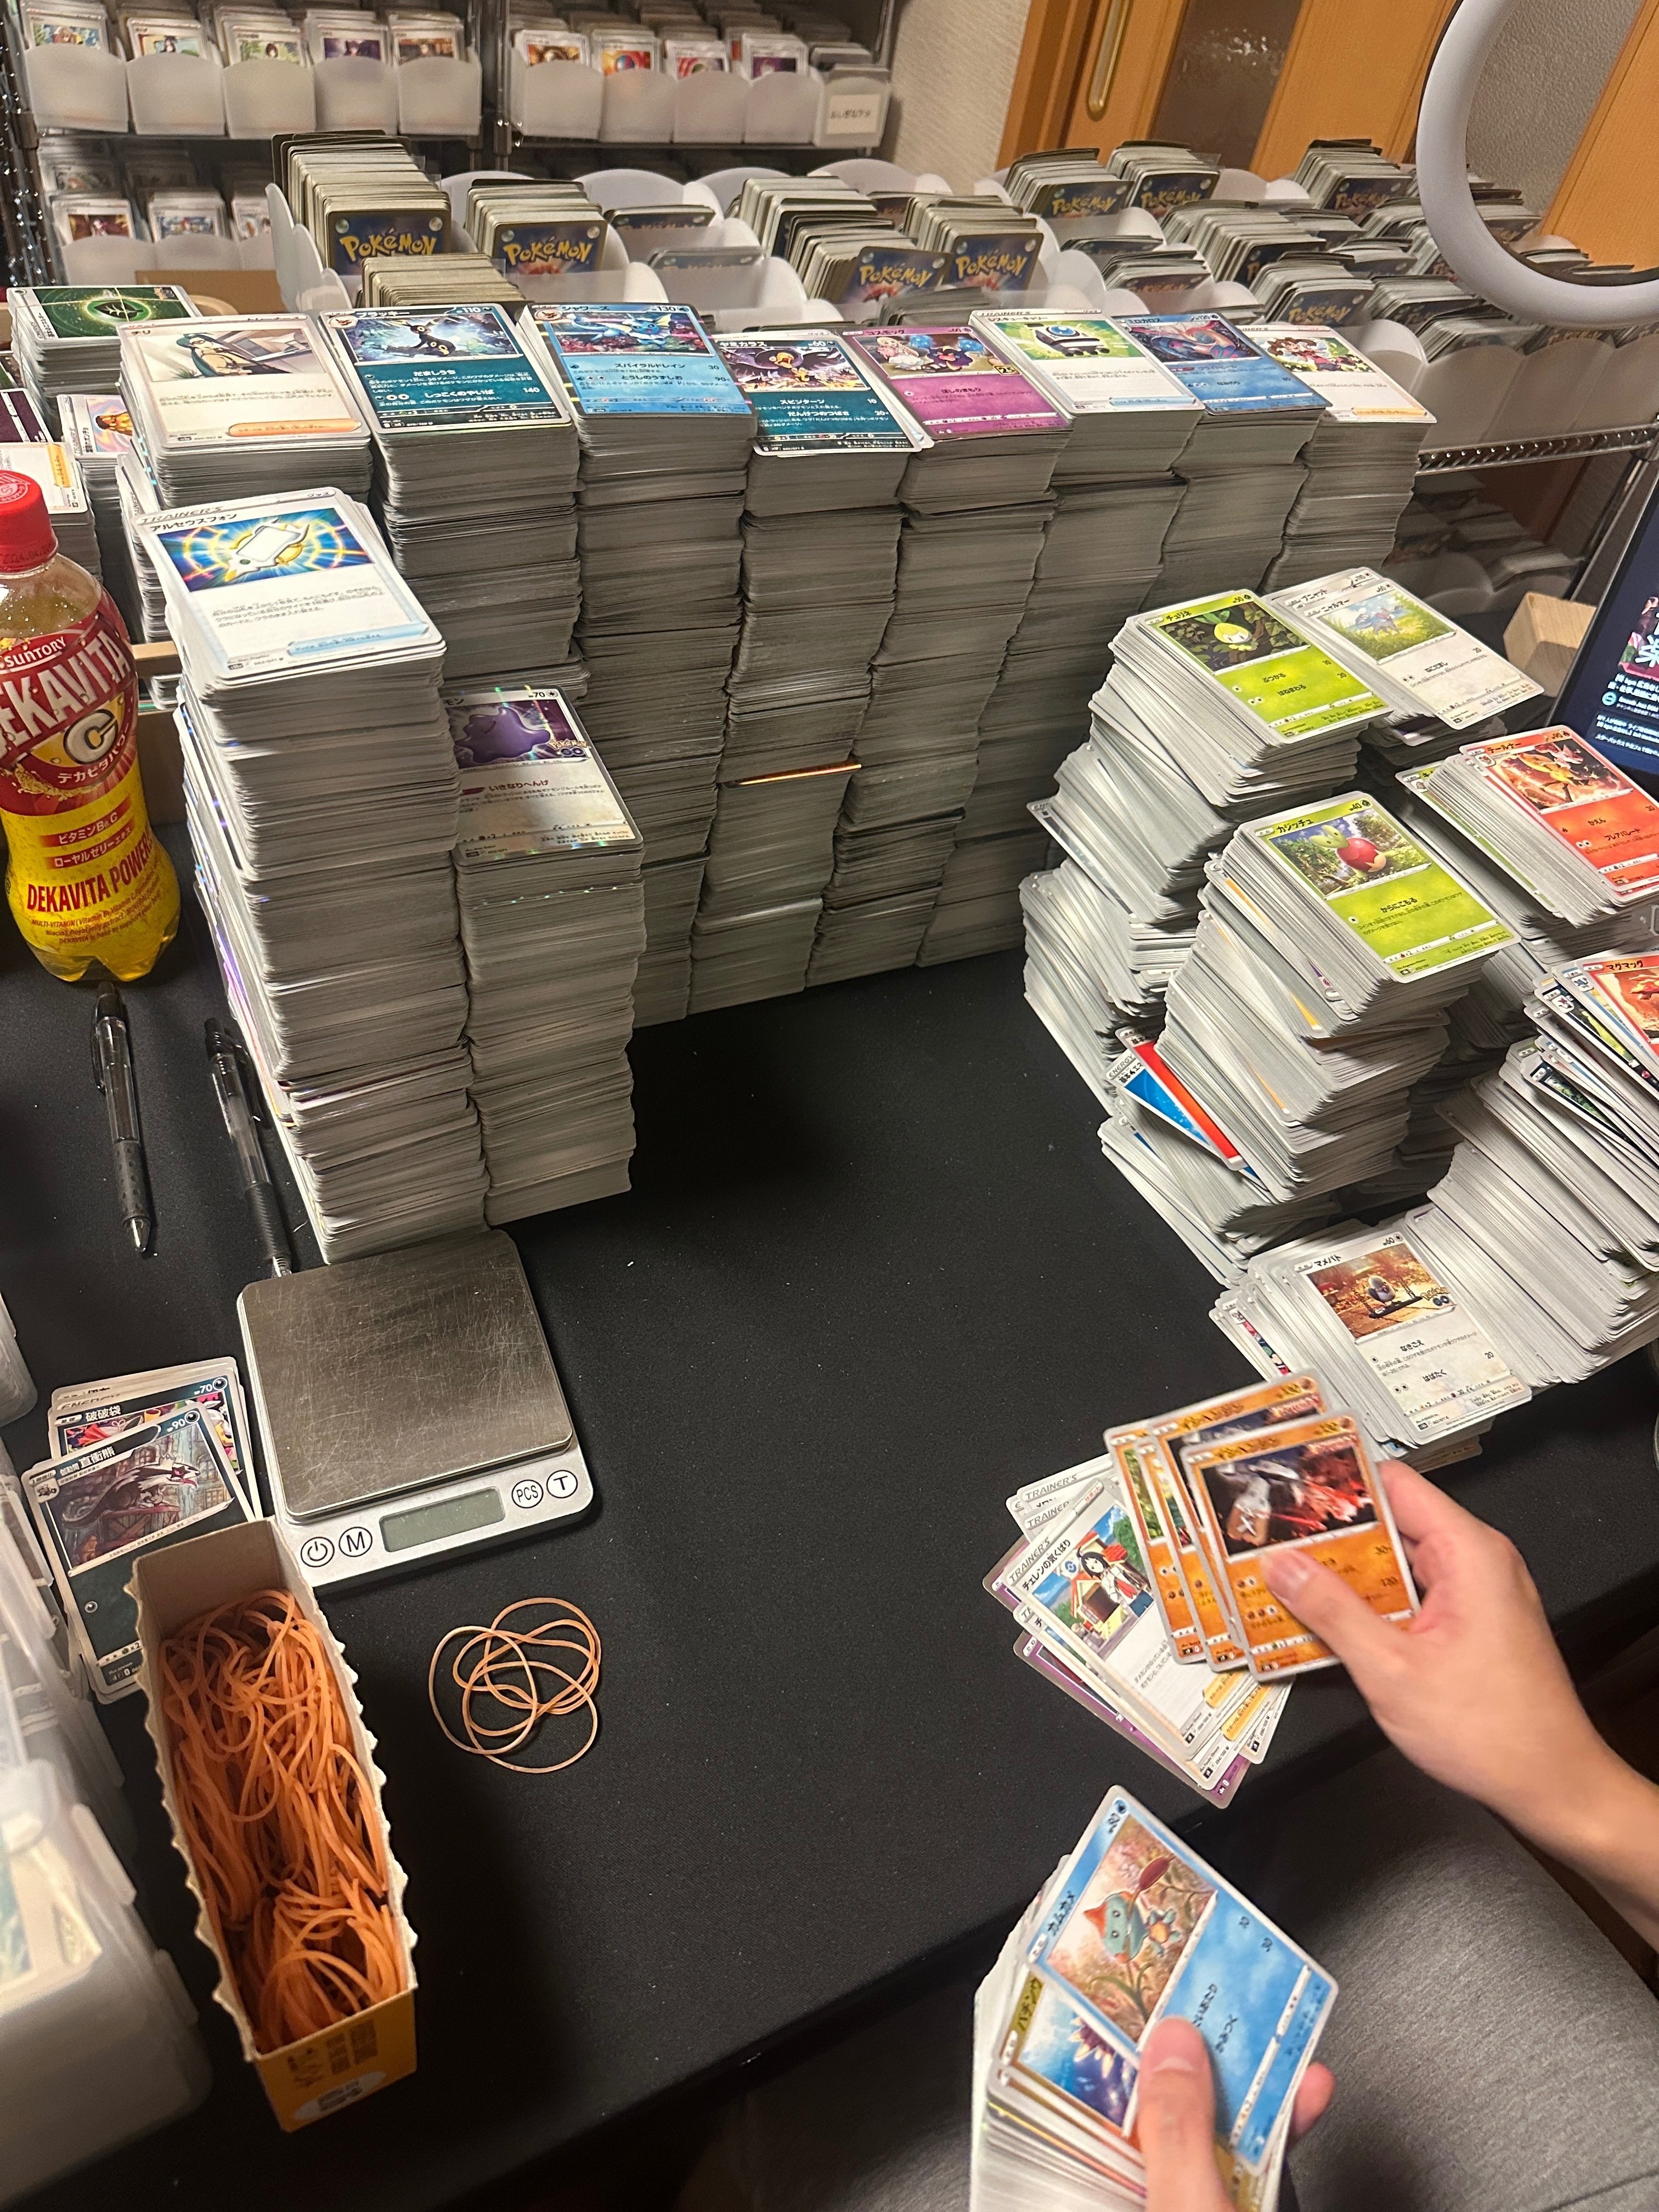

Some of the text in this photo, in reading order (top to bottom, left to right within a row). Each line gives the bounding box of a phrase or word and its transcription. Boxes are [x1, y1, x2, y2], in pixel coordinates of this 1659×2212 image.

[356, 309, 410, 318] ブラッキー
[413, 369, 456, 377] だましうち
[425, 389, 495, 398] しっこくのやいば
[141, 505, 223, 525] TRAINER'S
[150, 513, 237, 532] アルセウスフォン
[1321, 599, 1350, 613] ニャルマー
[1165, 610, 1193, 622] チュリネ
[5, 636, 66, 668] SUNTORY
[1262, 673, 1286, 683] ぶつかる
[58, 721, 130, 783] デカビタパワー
[1487, 741, 1522, 754] テールナー
[488, 779, 549, 792] いきなりへんげ
[1352, 802, 1362, 811] 40
[1276, 817, 1314, 834] カジッチュ
[54, 827, 132, 868] ローヤルゼリーエキス
[27, 873, 111, 912] DEKAVITA
[1380, 898, 1418, 913] からにこもる
[1606, 960, 1644, 971] マグマッグ
[1108, 1053, 1135, 1078] ENERGY
[1386, 1237, 1395, 1245] 60
[1422, 1368, 1447, 1383] はばたく
[200, 1384, 213, 1393] 70
[85, 1404, 121, 1422] 破破袋
[172, 1418, 185, 1430] 90
[555, 1476, 569, 1491] T
[1025, 1474, 1077, 1499] TRAINER'S
[516, 1486, 539, 1503] PCS
[1085, 1485, 1102, 1503] サポート
[346, 1532, 365, 1552] M
[1009, 1536, 1051, 1582] TRAINER'S
[1022, 1539, 1071, 1591] チェレンの気くばり
